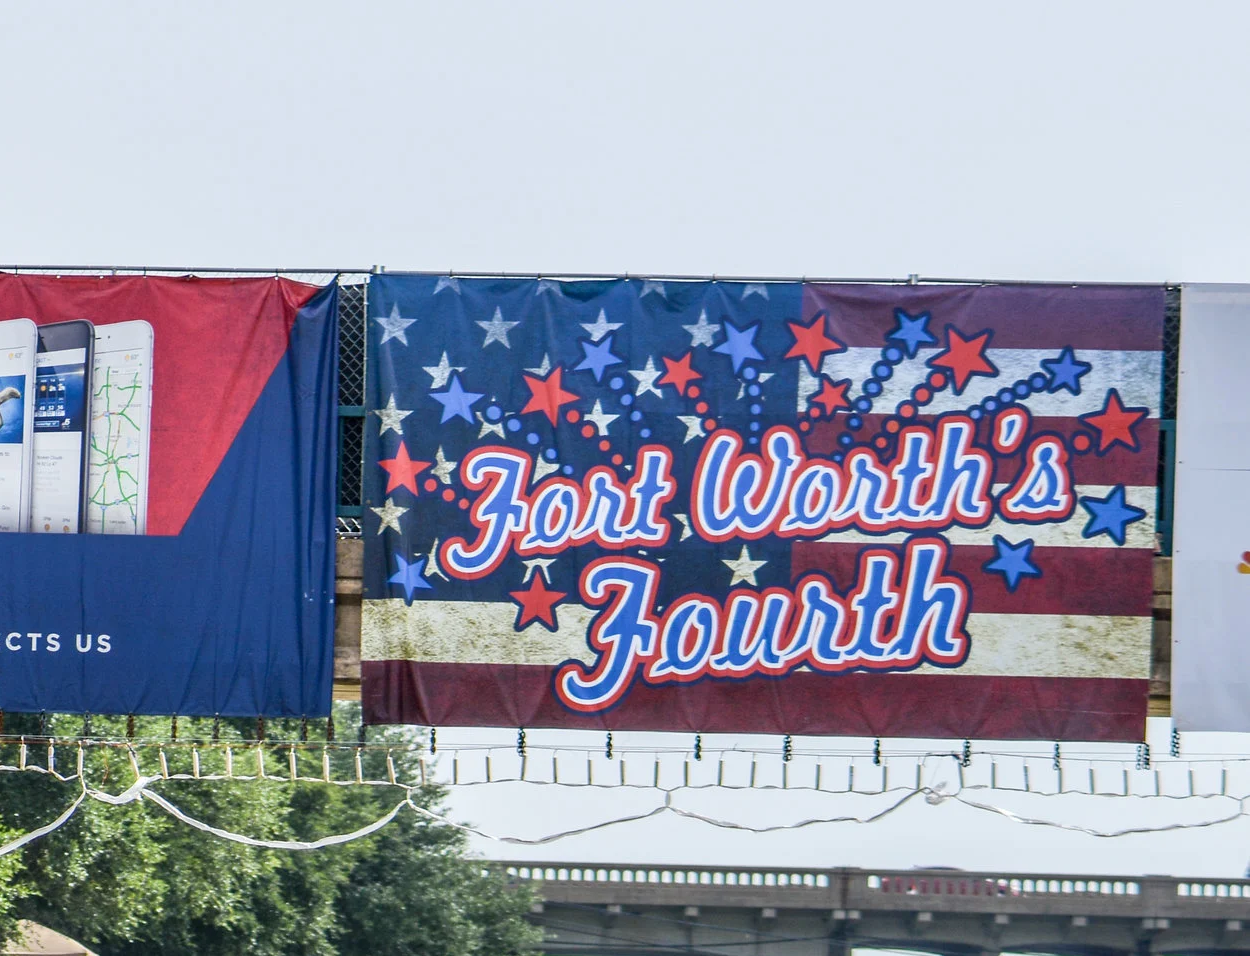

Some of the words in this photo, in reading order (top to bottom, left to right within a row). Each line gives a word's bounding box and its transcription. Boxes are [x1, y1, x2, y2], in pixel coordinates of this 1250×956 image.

[444, 445, 676, 578] Fort
[692, 407, 1071, 541] Worth's
[75, 634, 112, 654] US
[557, 537, 970, 711] Fourth
